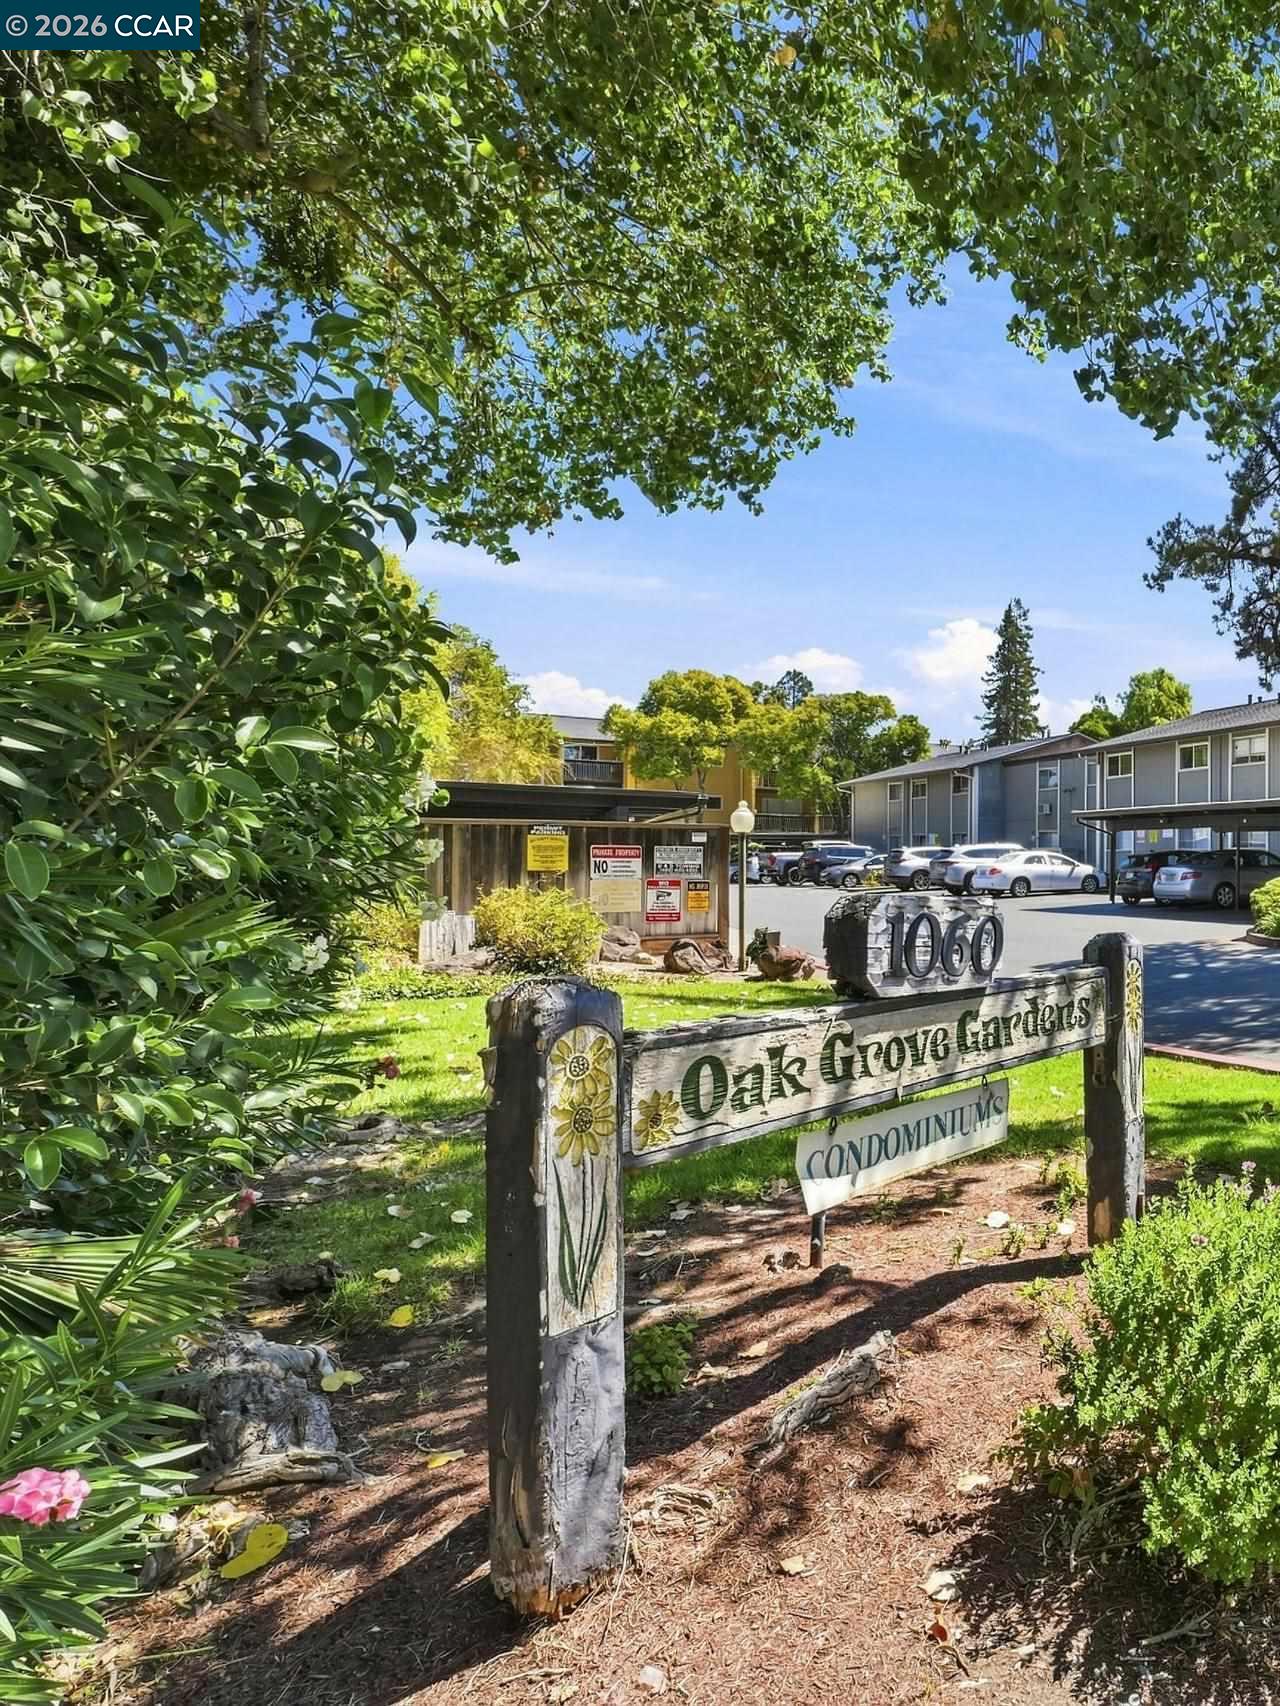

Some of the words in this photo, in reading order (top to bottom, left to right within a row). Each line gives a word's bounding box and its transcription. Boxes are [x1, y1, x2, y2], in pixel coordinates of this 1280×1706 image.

[593, 860, 608, 874] NO
[886, 910, 1004, 978] 1060
[680, 1043, 811, 1121] Oak
[819, 1024, 950, 1085] Grove
[957, 996, 1091, 1054] Gardens
[805, 1094, 1004, 1187] CONDOMINIUMS
